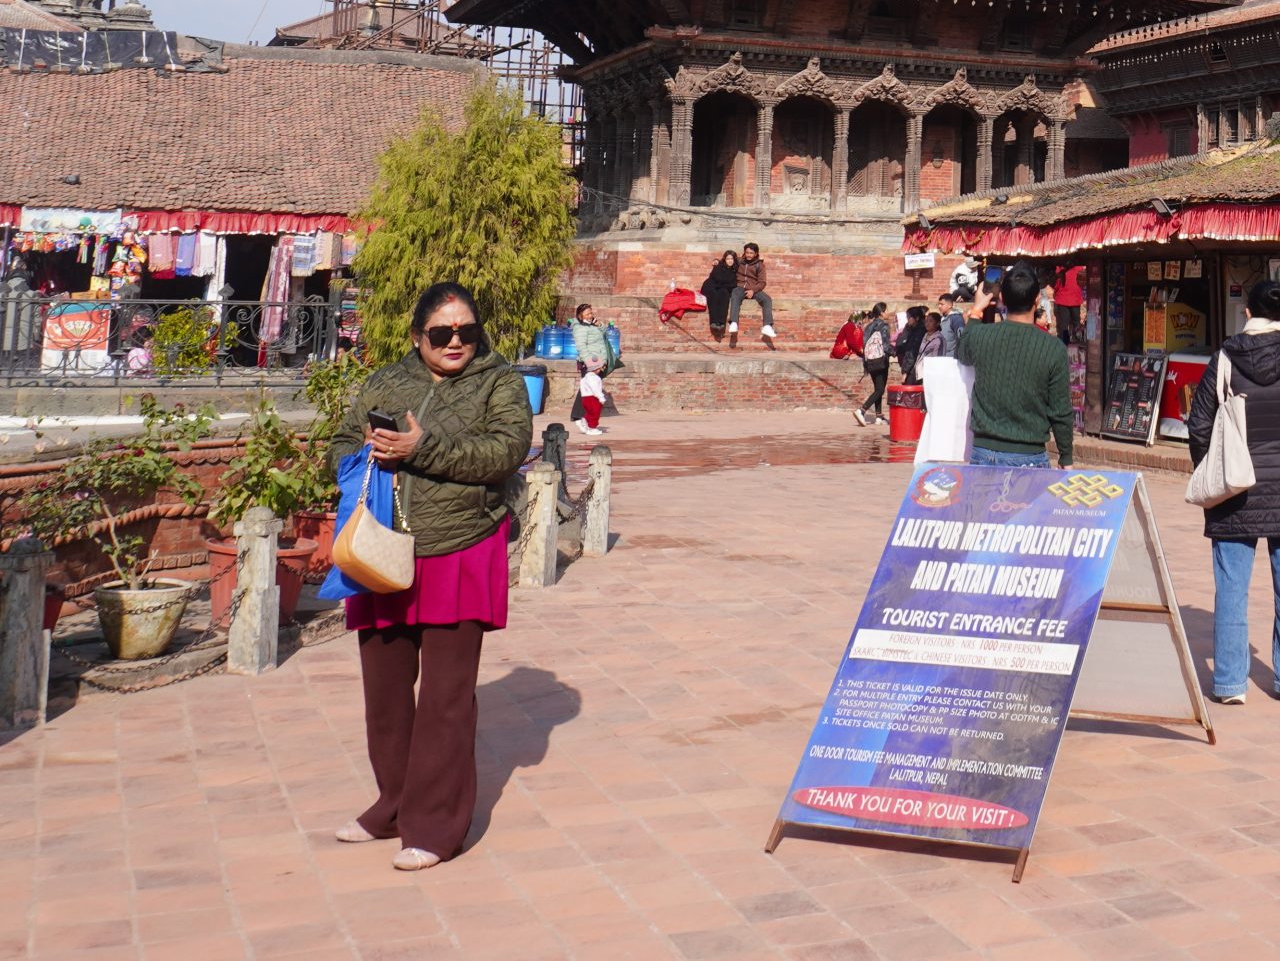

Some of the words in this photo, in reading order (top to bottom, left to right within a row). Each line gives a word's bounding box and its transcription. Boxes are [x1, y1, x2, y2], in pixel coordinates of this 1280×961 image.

[1053, 508, 1075, 516] PATAN
[1075, 509, 1106, 517] MUSEUM
[891, 518, 963, 550] LALITPUR
[960, 522, 1077, 556] METROPOLITAN
[1072, 527, 1113, 558] CITY
[910, 560, 948, 590] AND
[943, 562, 994, 594] PATAN
[991, 565, 1064, 599] MUSEUM
[882, 608, 949, 629] TOURIST
[950, 613, 1036, 635] ENTRANCE
[1036, 619, 1068, 638] FEE
[889, 633, 922, 645] FOREIGN
[923, 636, 956, 647] VISITORS
[980, 639, 998, 651] 1000
[998, 643, 1012, 652] PER
[1013, 644, 1043, 655] PERSON
[921, 651, 953, 663] CHINESE
[954, 654, 986, 665] VISITORS
[1010, 657, 1026, 668] 500
[1026, 659, 1040, 669] PER
[1040, 661, 1072, 672] PERSON
[838, 679, 844, 687] 1.
[846, 679, 864, 689] THIS
[866, 681, 890, 690] TICKET
[892, 683, 900, 691] IS
[901, 684, 924, 693] VALID
[925, 685, 942, 694] FOR
[944, 687, 959, 695] THE
[960, 689, 982, 698] ISSUE
[984, 691, 1004, 699] DATE
[1006, 693, 1028, 702] ONLY.
[842, 689, 858, 697] FOR
[860, 691, 896, 701] MULTIPLE
[897, 693, 922, 703] ENTRY
[924, 695, 951, 705] PLEASE
[953, 699, 992, 709] CONTACT
[992, 702, 1004, 710] US
[1006, 703, 1027, 712] WITH
[1029, 705, 1052, 714] YOUR
[835, 708, 852, 717] SITE
[852, 709, 880, 719] OFFICE
[880, 711, 906, 721] PATAN
[908, 713, 944, 725] MUSEUM.
[839, 699, 878, 709] PASSPORT
[880, 702, 928, 713] PHOTOCOPY
[950, 708, 967, 717] SIZE
[968, 709, 998, 719] PHOTO
[1010, 714, 1040, 723] ODTFM
[1040, 716, 1048, 724] &
[1050, 717, 1060, 725] IC
[822, 717, 829, 725] 3.
[831, 717, 862, 727] TICKETS
[862, 720, 888, 729] ONCE
[886, 722, 909, 731] SOLD
[910, 725, 928, 733] CAN
[929, 727, 948, 735] NOT
[810, 745, 826, 757] ONE
[824, 747, 844, 759] DOOR
[844, 748, 874, 763] TOURISM
[872, 751, 885, 763] FEE
[884, 752, 932, 767] MANAGEMENT
[930, 757, 946, 769] AND
[946, 759, 1004, 775] IMPLEMENTATION
[1004, 764, 1043, 779] COMMITTEE
[889, 768, 924, 784] LALITPUR,
[925, 771, 948, 785] NEPAL
[806, 789, 857, 809] THANK
[860, 795, 891, 812] YOU
[893, 799, 922, 816] FOR
[924, 801, 966, 821] YOUR
[972, 807, 1008, 825] VISIT
[1008, 815, 1014, 827] !
